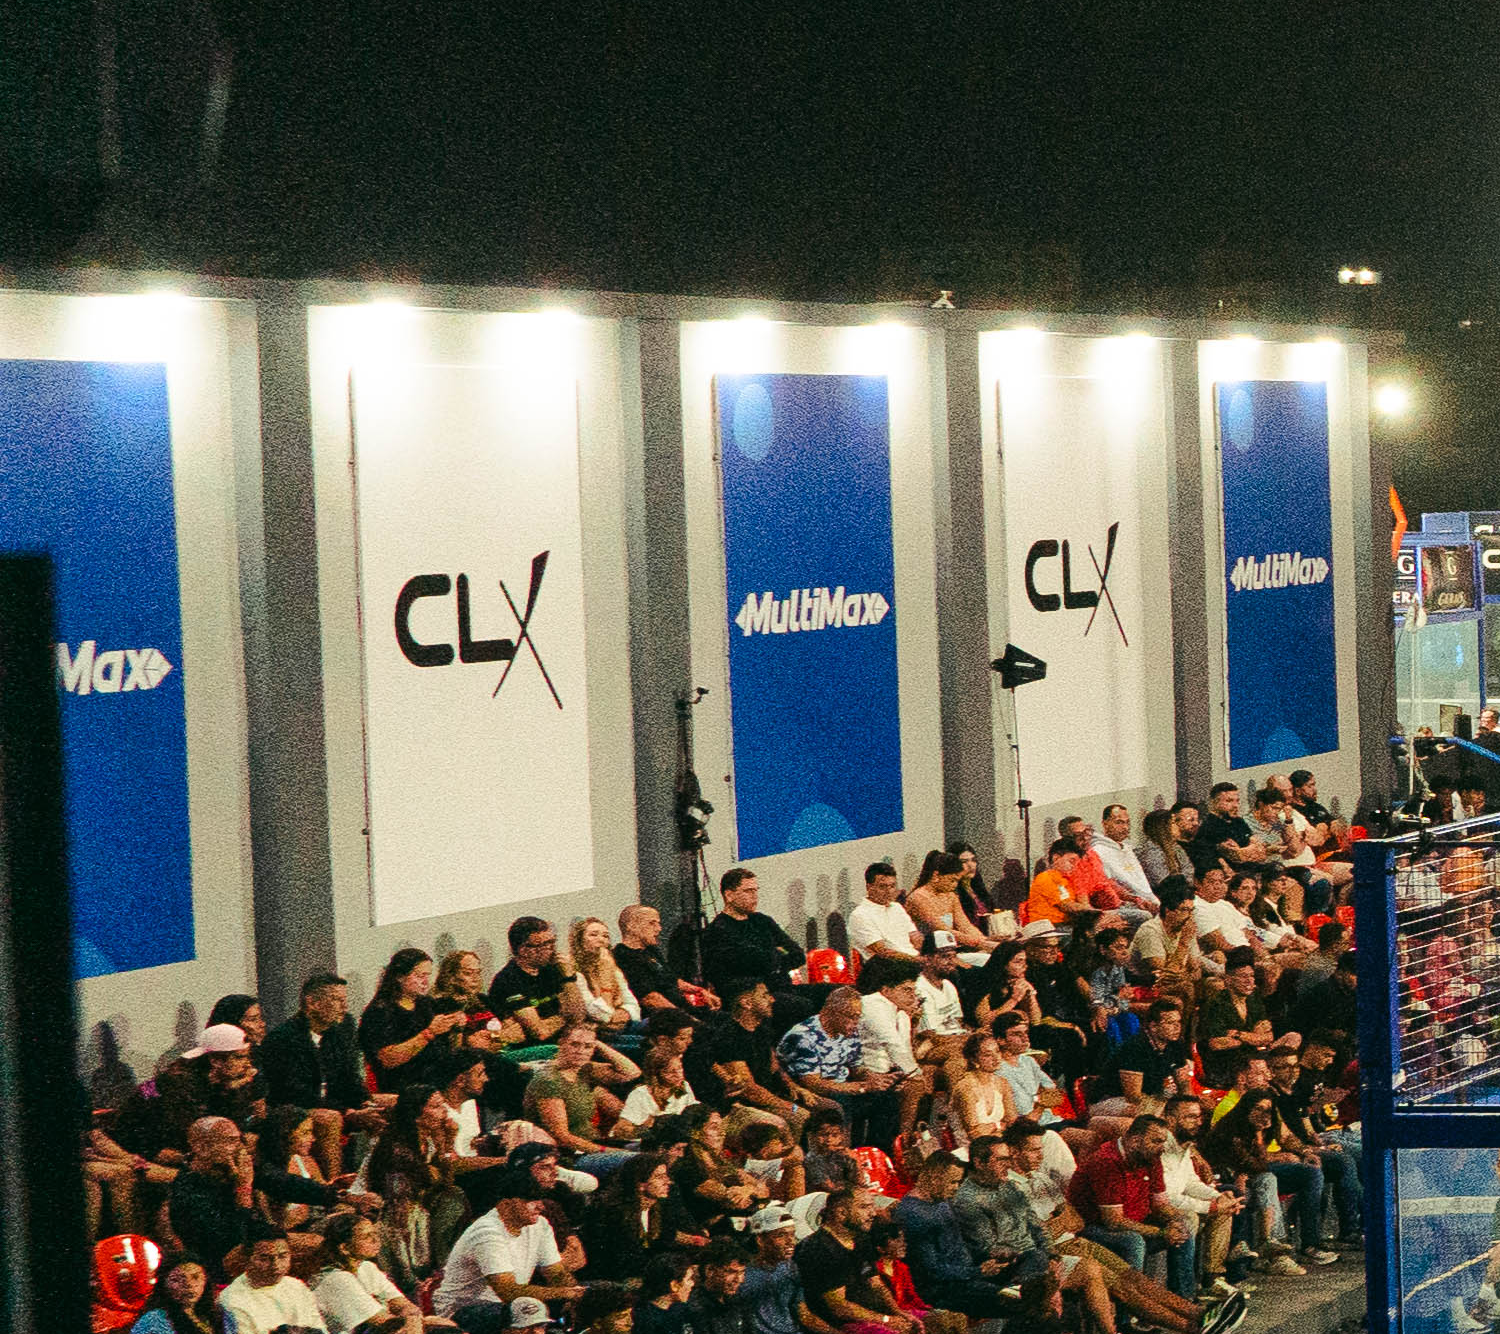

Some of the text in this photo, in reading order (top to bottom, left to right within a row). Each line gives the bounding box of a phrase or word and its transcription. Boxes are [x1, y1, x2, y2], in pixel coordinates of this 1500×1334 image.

[736, 585, 888, 638] MultiMax
[1025, 521, 1128, 647] CLX
[1231, 552, 1328, 592] MultiMax
[395, 550, 563, 710] CLX
